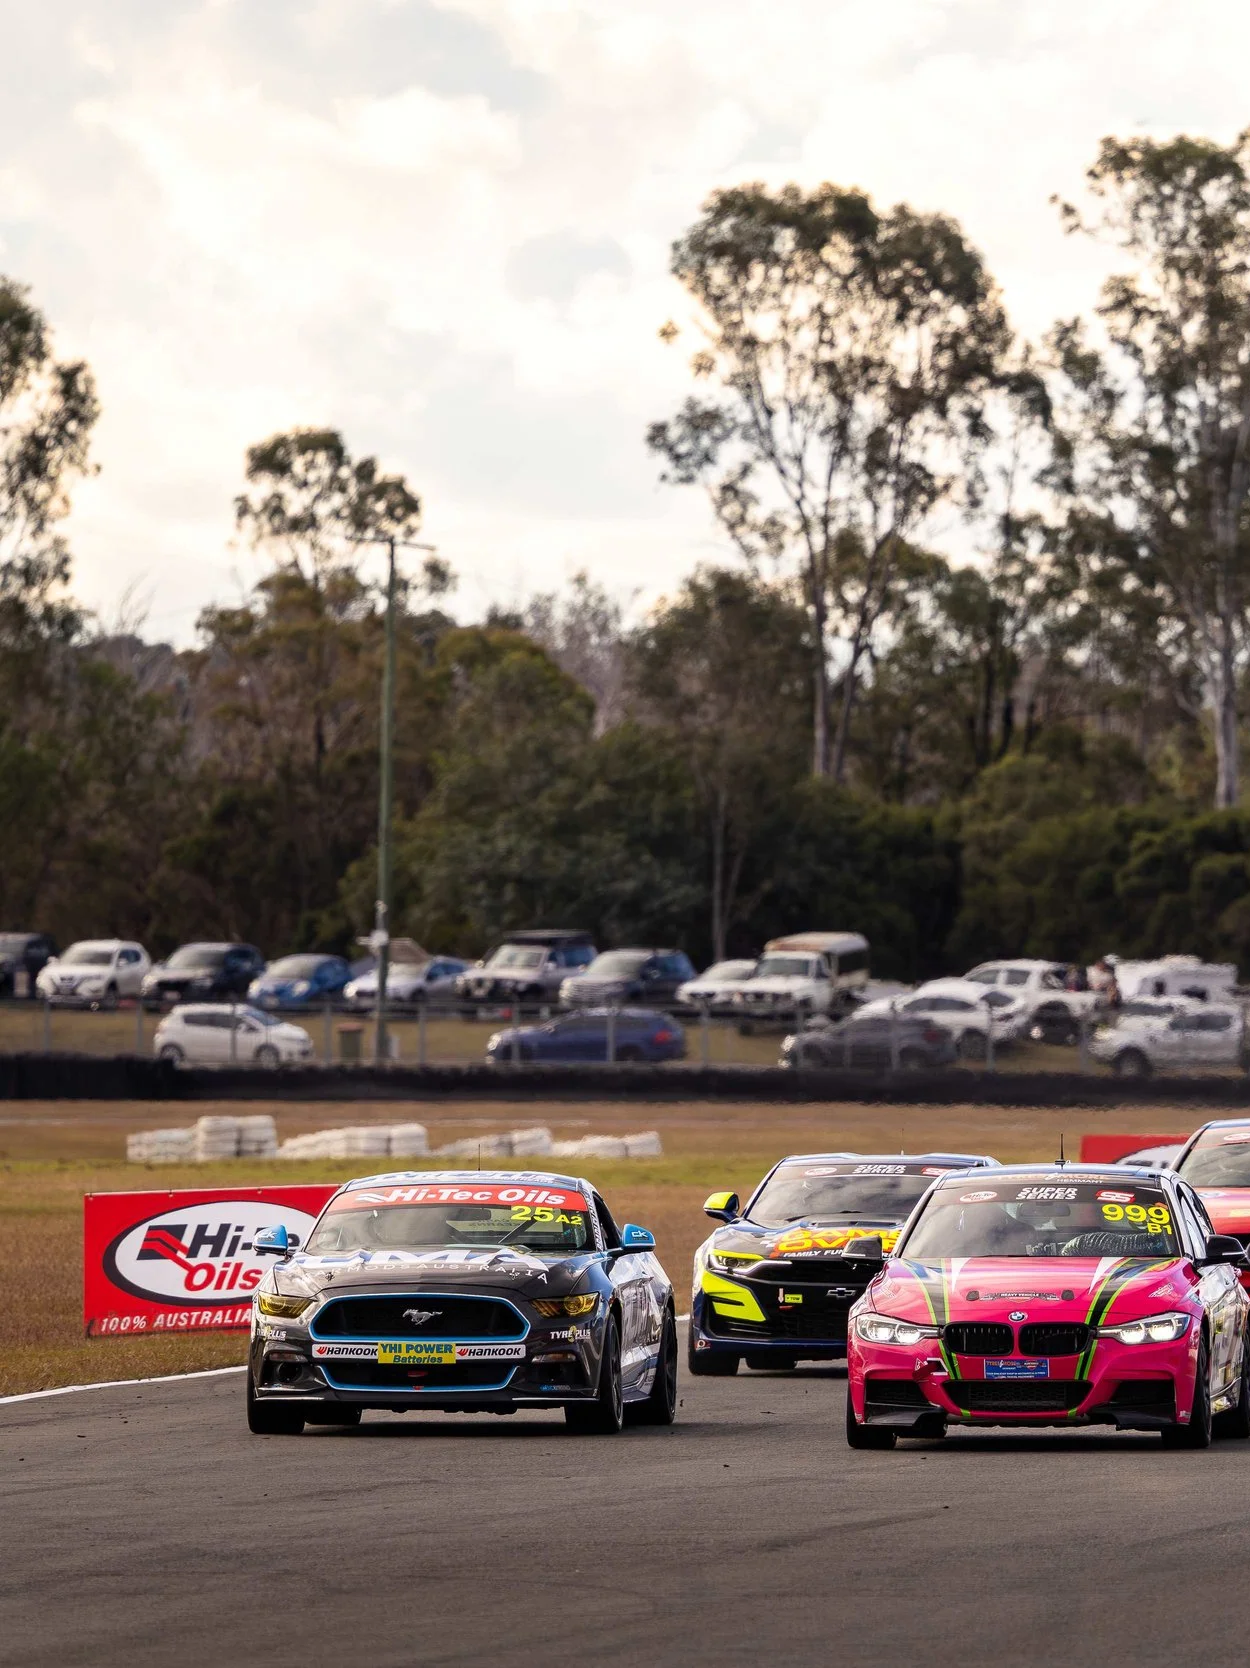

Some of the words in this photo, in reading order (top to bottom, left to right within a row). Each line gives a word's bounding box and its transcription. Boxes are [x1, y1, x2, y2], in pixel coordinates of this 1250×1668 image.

[388, 1188, 493, 1201] Hi-Tec
[497, 1188, 566, 1205] Oils
[1015, 1192, 1077, 1200] SERIES
[510, 1206, 554, 1223] 25
[555, 1214, 583, 1226] A2
[1101, 1203, 1171, 1225] 999
[1146, 1222, 1173, 1236] B1
[184, 1261, 263, 1292] Oils
[100, 1315, 147, 1333] 100%
[574, 1328, 591, 1337] PLUS
[380, 1343, 402, 1353] YHI
[405, 1343, 454, 1353] POWER
[392, 1354, 443, 1364] Batteries
